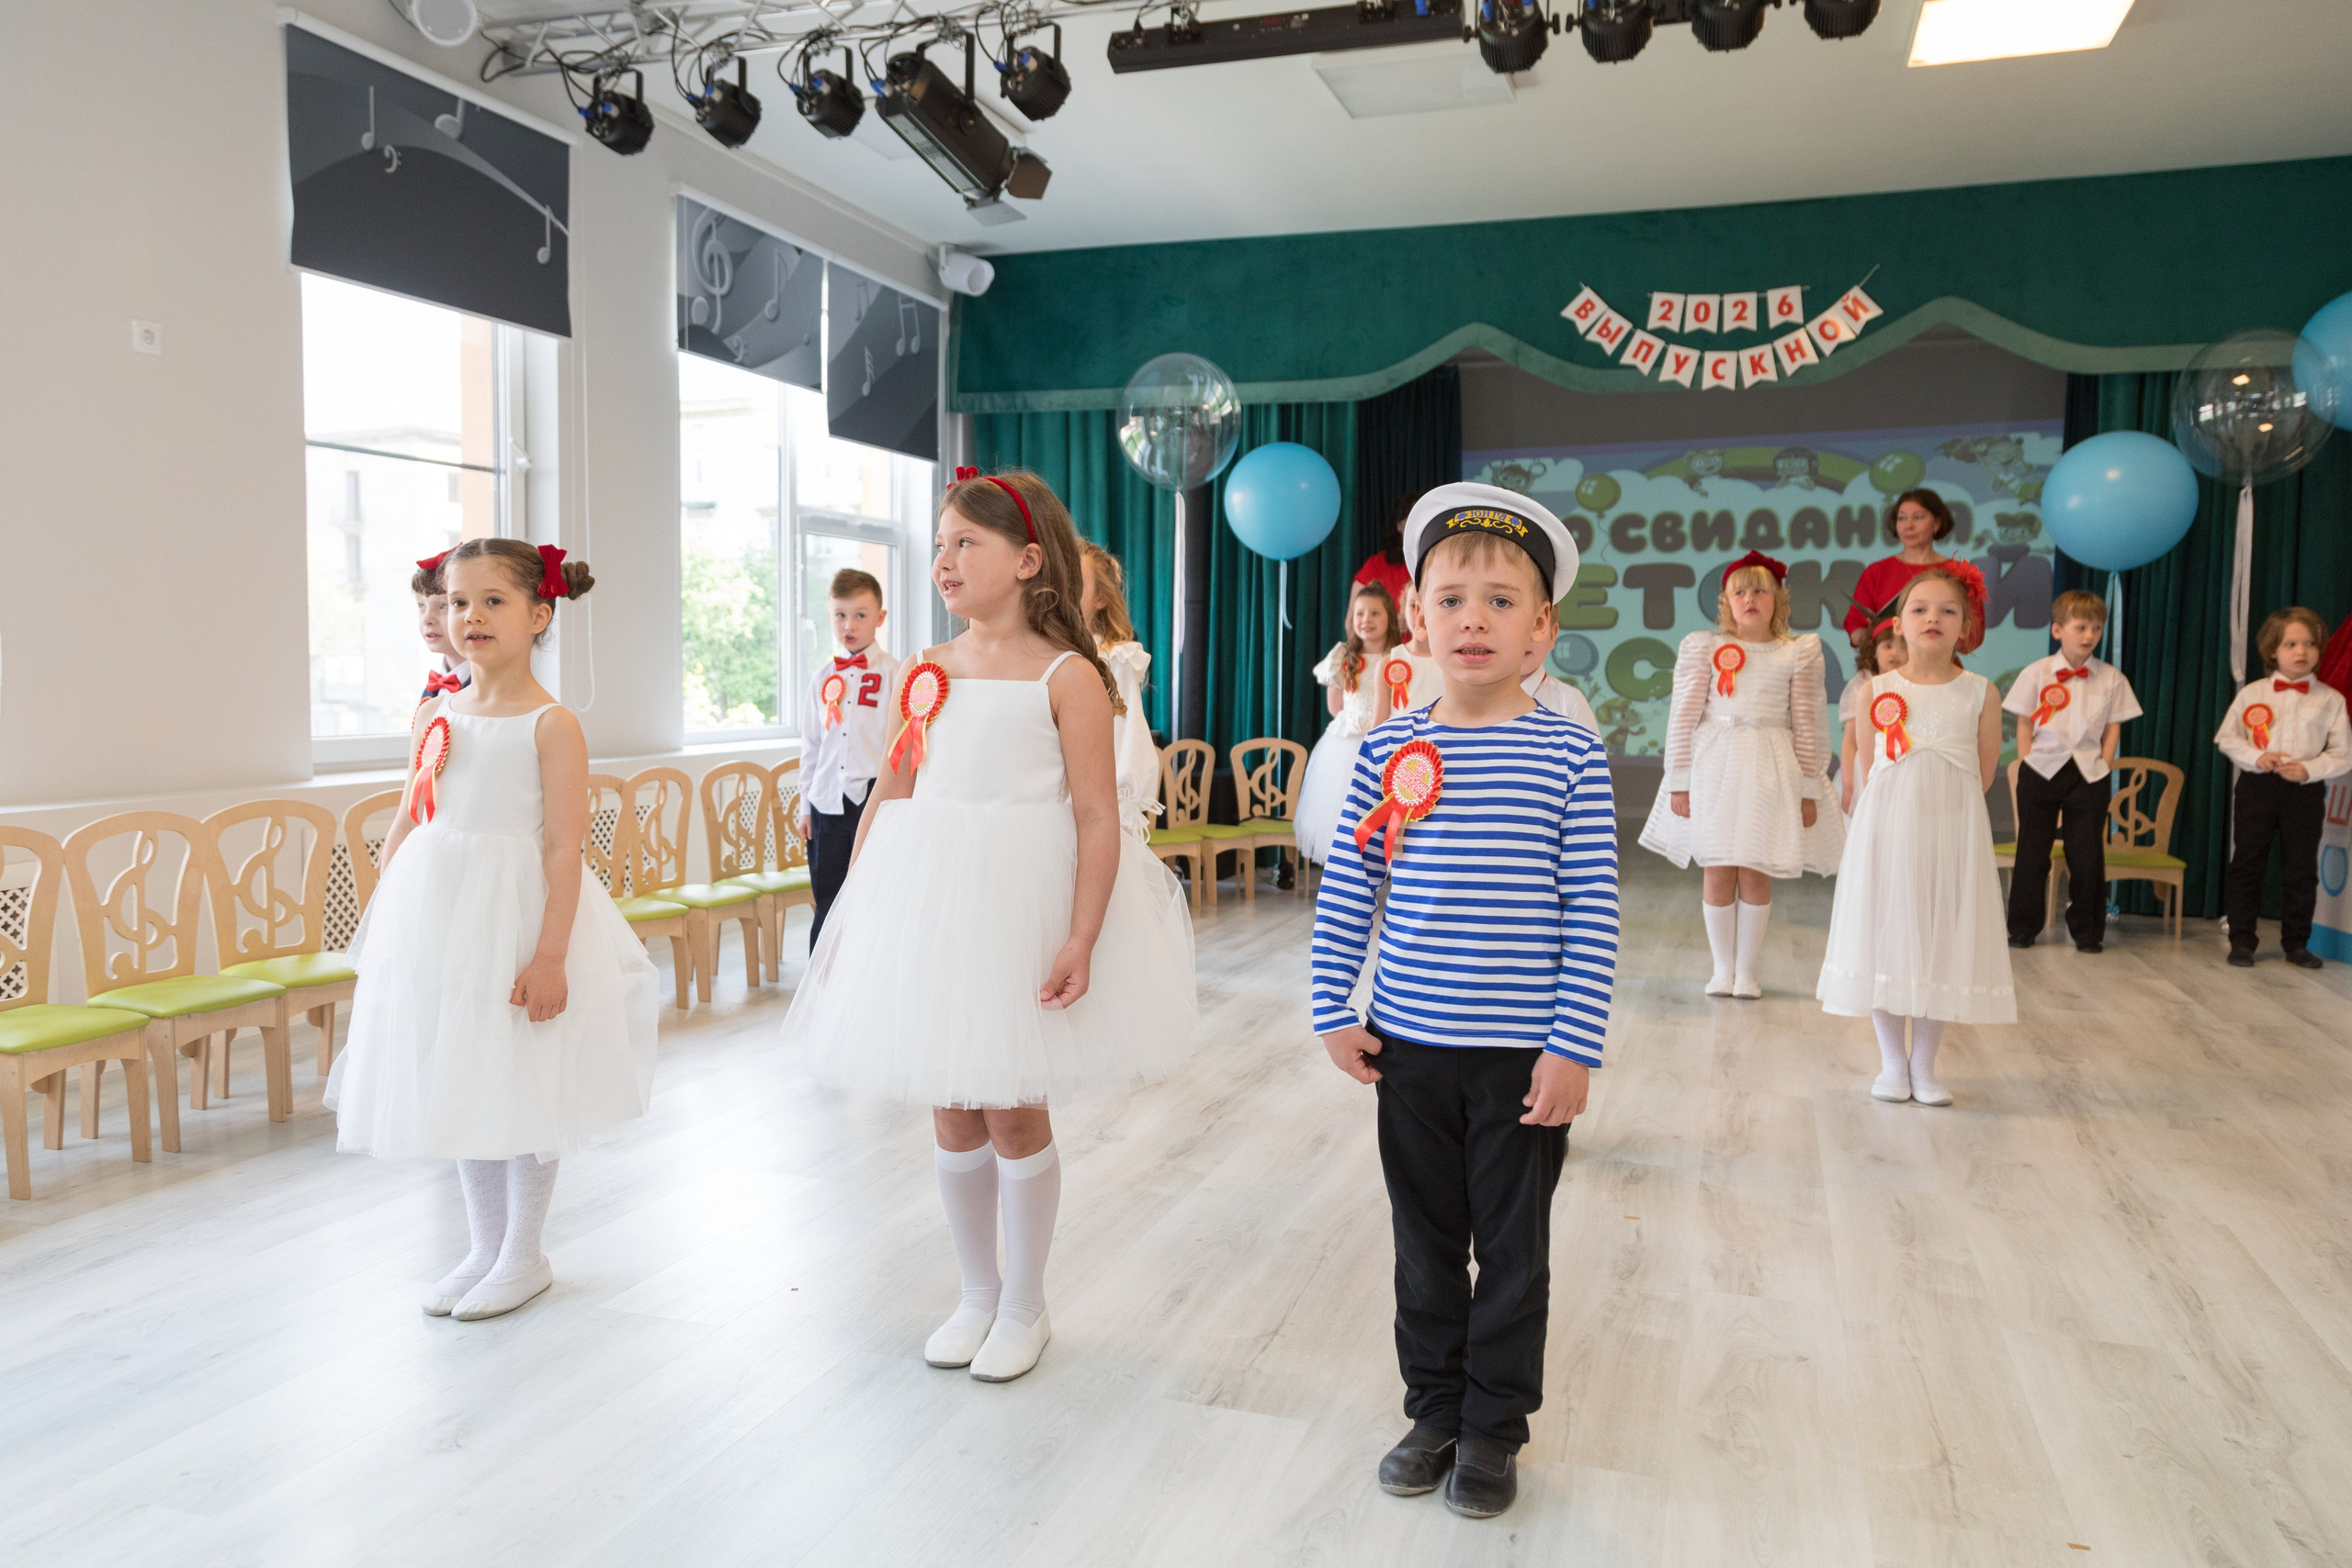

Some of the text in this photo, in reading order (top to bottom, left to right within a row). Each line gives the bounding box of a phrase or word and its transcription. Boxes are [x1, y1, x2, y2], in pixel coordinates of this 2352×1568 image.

[1658, 294, 1794, 323] 2026
[1574, 292, 1871, 381] ВЫПУСКНОЙ
[857, 672, 882, 708] 2
